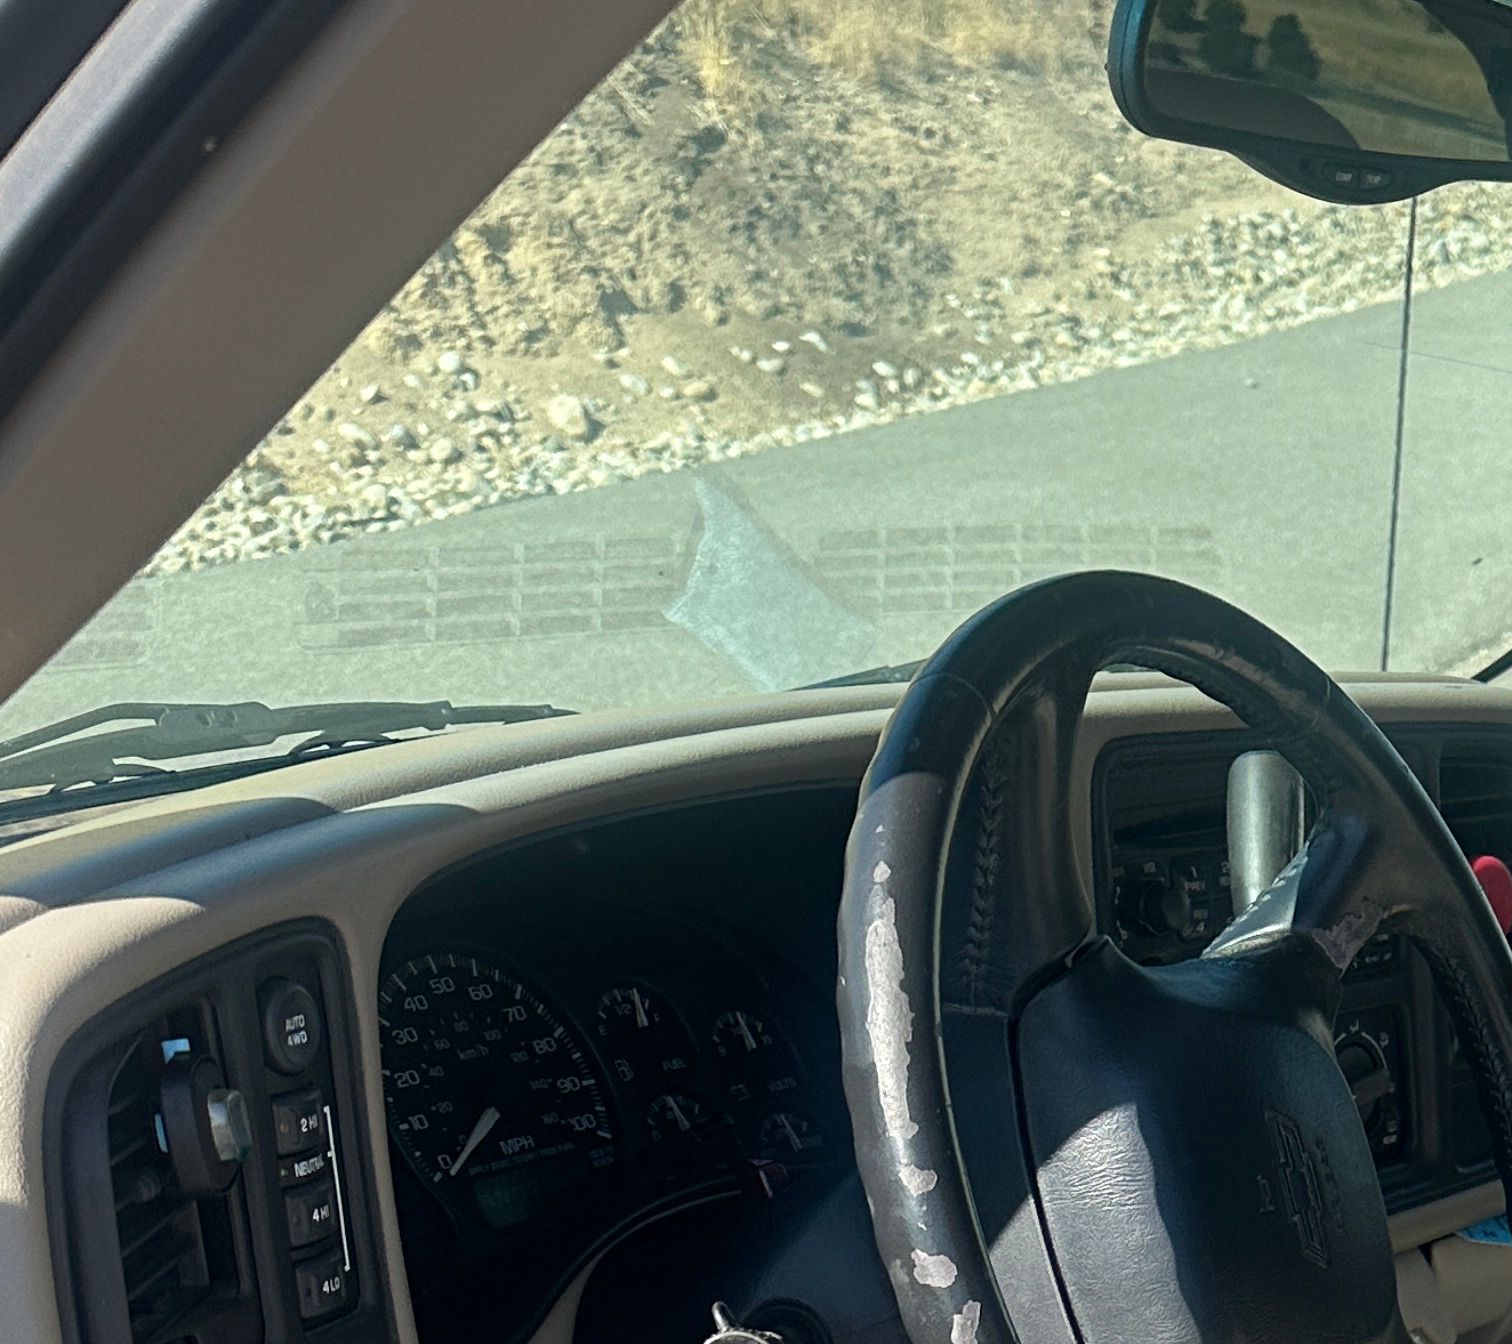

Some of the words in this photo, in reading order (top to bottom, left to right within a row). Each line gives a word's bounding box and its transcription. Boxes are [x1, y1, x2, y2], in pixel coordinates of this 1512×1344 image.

[428, 976, 456, 995] 50
[467, 983, 494, 1001] 60
[403, 994, 429, 1012] 40
[285, 1014, 306, 1032] AUTO
[501, 1005, 528, 1023] 70
[453, 1020, 470, 1033] 80
[287, 1032, 308, 1048] 4WD
[391, 1027, 419, 1046] 30
[433, 1038, 451, 1050] 60
[456, 1043, 490, 1061] km/h
[532, 1037, 557, 1055] 80
[393, 1069, 420, 1088] 20
[428, 1066, 445, 1078] 40
[556, 1076, 581, 1094] 90
[436, 1101, 453, 1113] 20
[300, 1117, 308, 1133] 2
[308, 1114, 318, 1130] HI
[408, 1113, 429, 1131] 10
[569, 1113, 597, 1131] 100
[499, 1135, 535, 1155] MPH
[437, 1154, 453, 1170] 0
[312, 1208, 320, 1223] 4
[321, 1205, 330, 1221] HI
[322, 1279, 330, 1295] 4
[330, 1275, 340, 1293] LO
